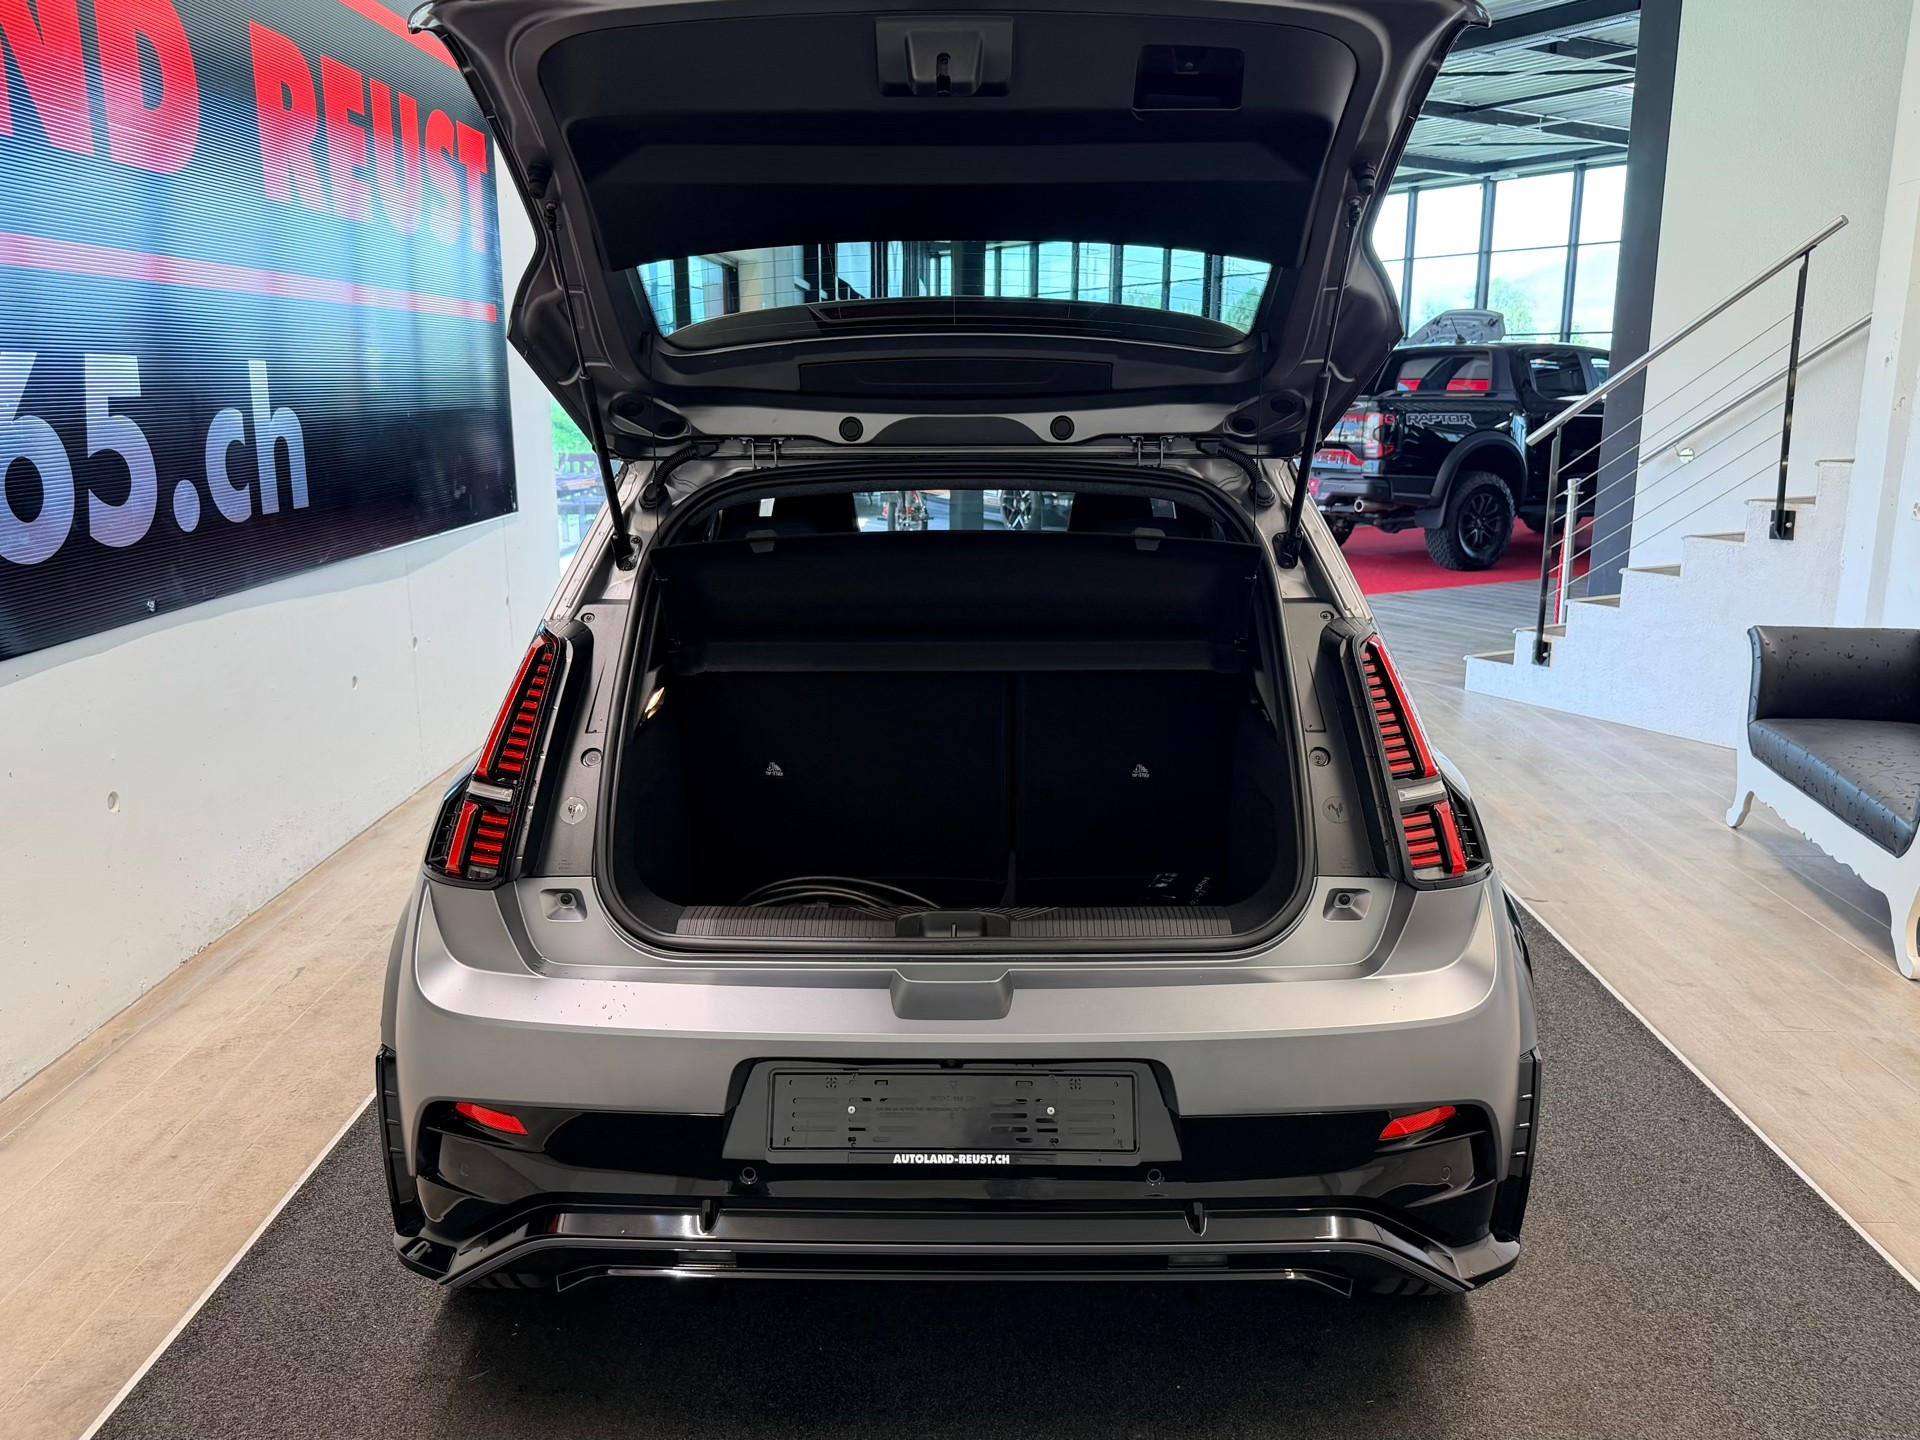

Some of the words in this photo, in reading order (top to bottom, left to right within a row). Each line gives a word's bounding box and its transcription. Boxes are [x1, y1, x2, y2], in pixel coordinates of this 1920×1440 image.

[249, 20, 488, 254] REUST
[0, 352, 310, 565] 65.ch
[1406, 413, 1477, 429] RAPTOR
[893, 1153, 1010, 1165] AUTOLAND-REUST.CH
